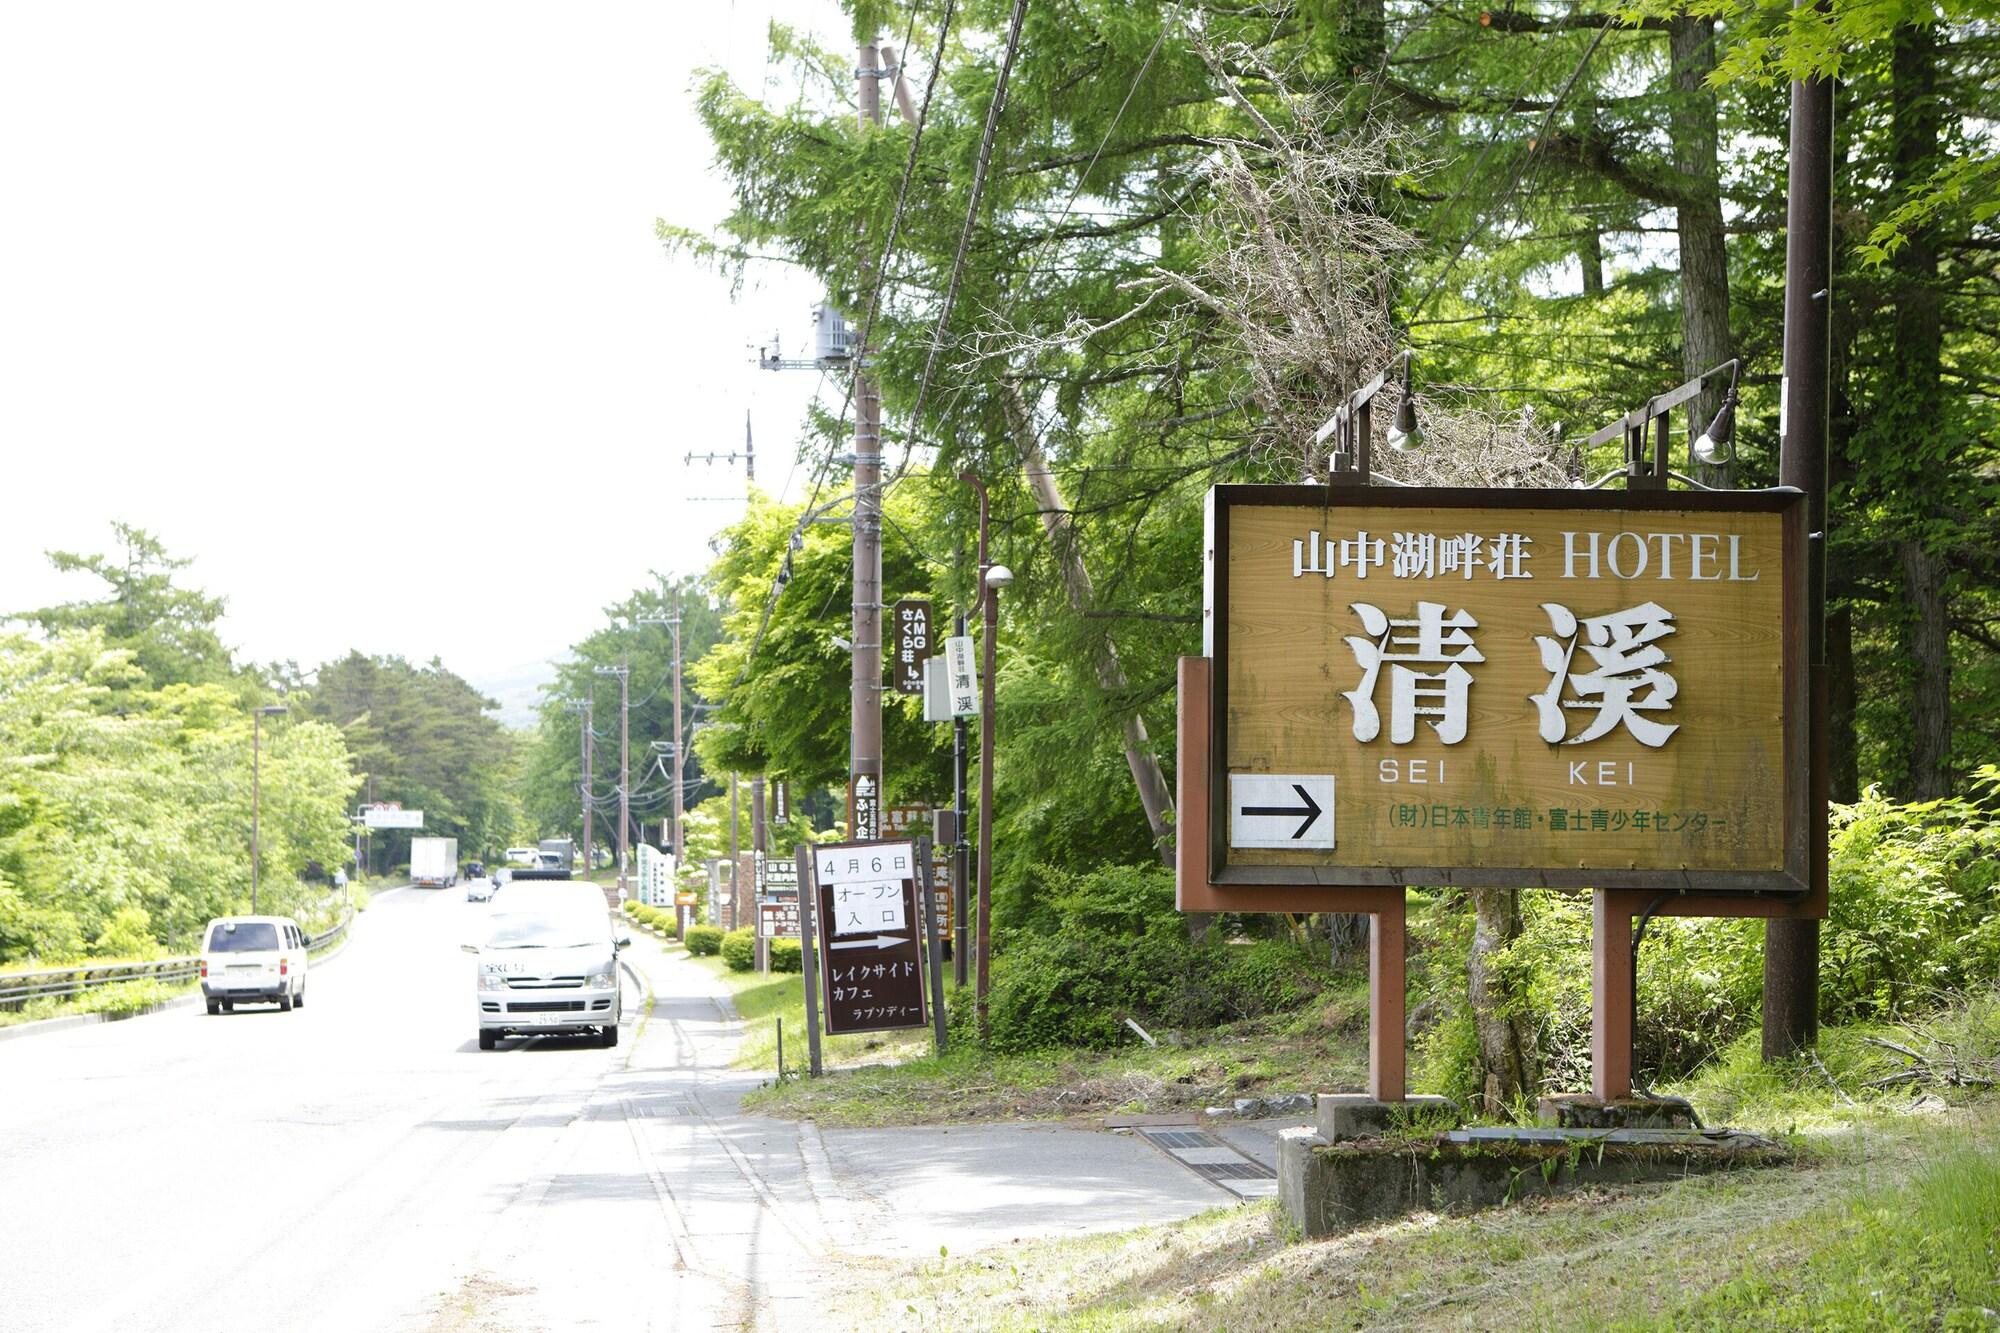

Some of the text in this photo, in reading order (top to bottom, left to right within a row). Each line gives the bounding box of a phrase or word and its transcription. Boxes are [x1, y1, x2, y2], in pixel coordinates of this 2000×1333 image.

[1292, 531, 1760, 581] 山中湖畔荘 HOTEL
[913, 608, 926, 649] AMG
[1378, 759, 1633, 786] SEI KEI
[824, 856, 906, 876] 4月6日
[837, 883, 900, 903] オープン
[847, 910, 896, 927] 入口
[832, 961, 914, 982] レイクサイド
[833, 985, 873, 1001] カフェ
